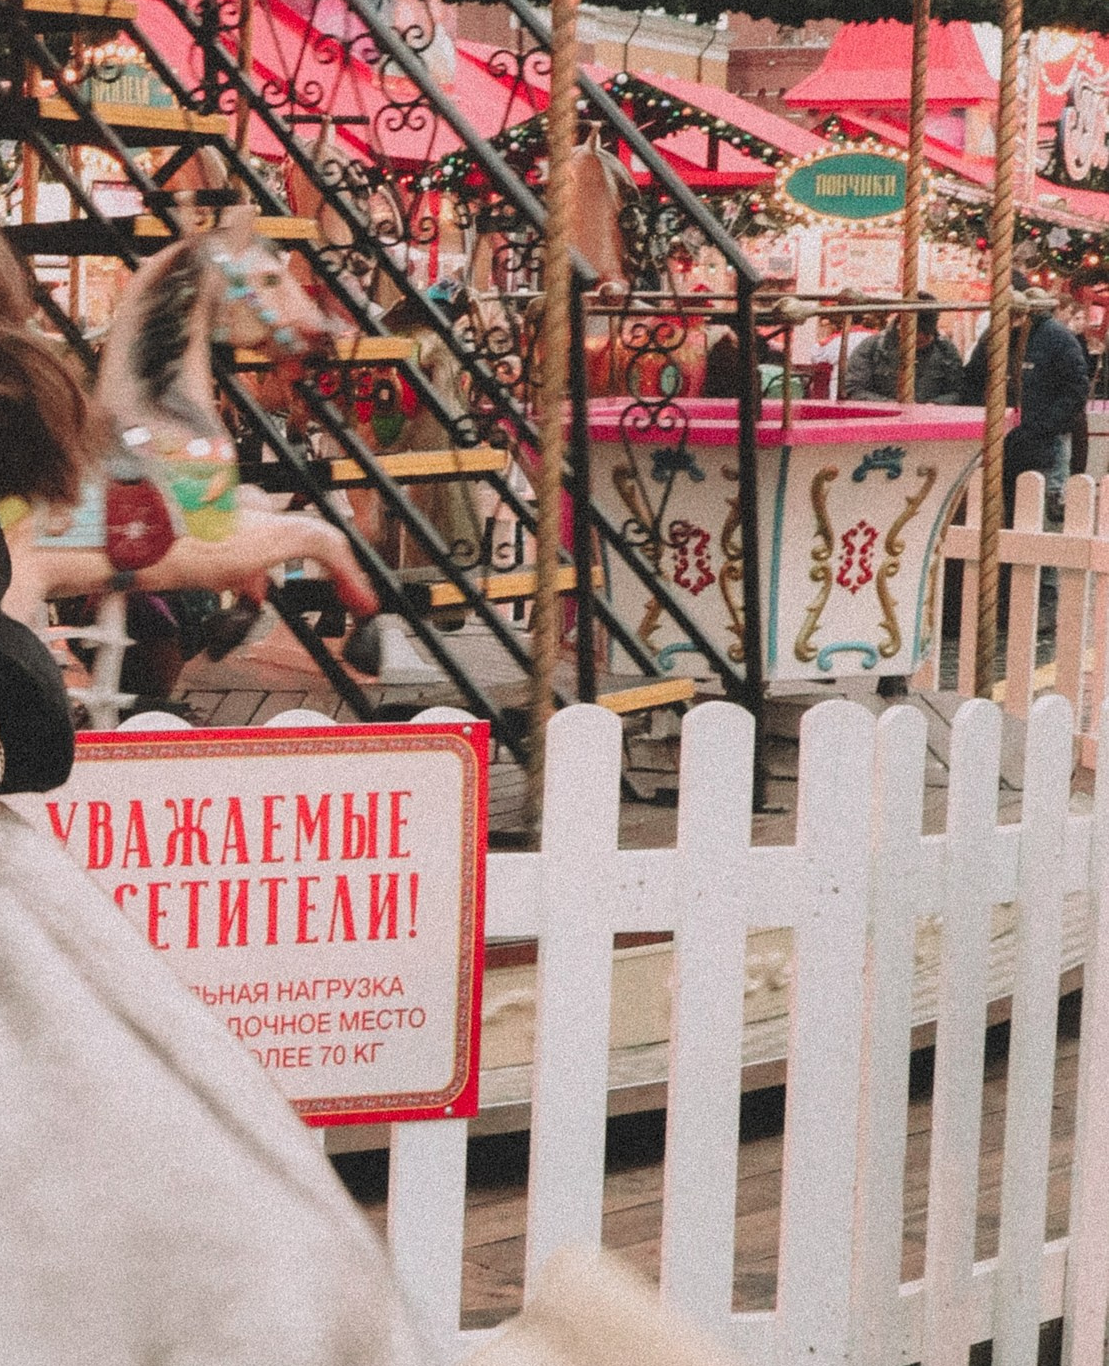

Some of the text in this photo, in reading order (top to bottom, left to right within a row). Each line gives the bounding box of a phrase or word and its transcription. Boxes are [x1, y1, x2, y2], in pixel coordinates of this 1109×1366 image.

[45, 791, 412, 870] УВАЖАЕМЫЕ
[277, 975, 405, 1002] НАГРУЗКА
[340, 1007, 427, 1032] МЕСТО
[321, 1045, 346, 1067] 70
[354, 1042, 385, 1065] КГ
